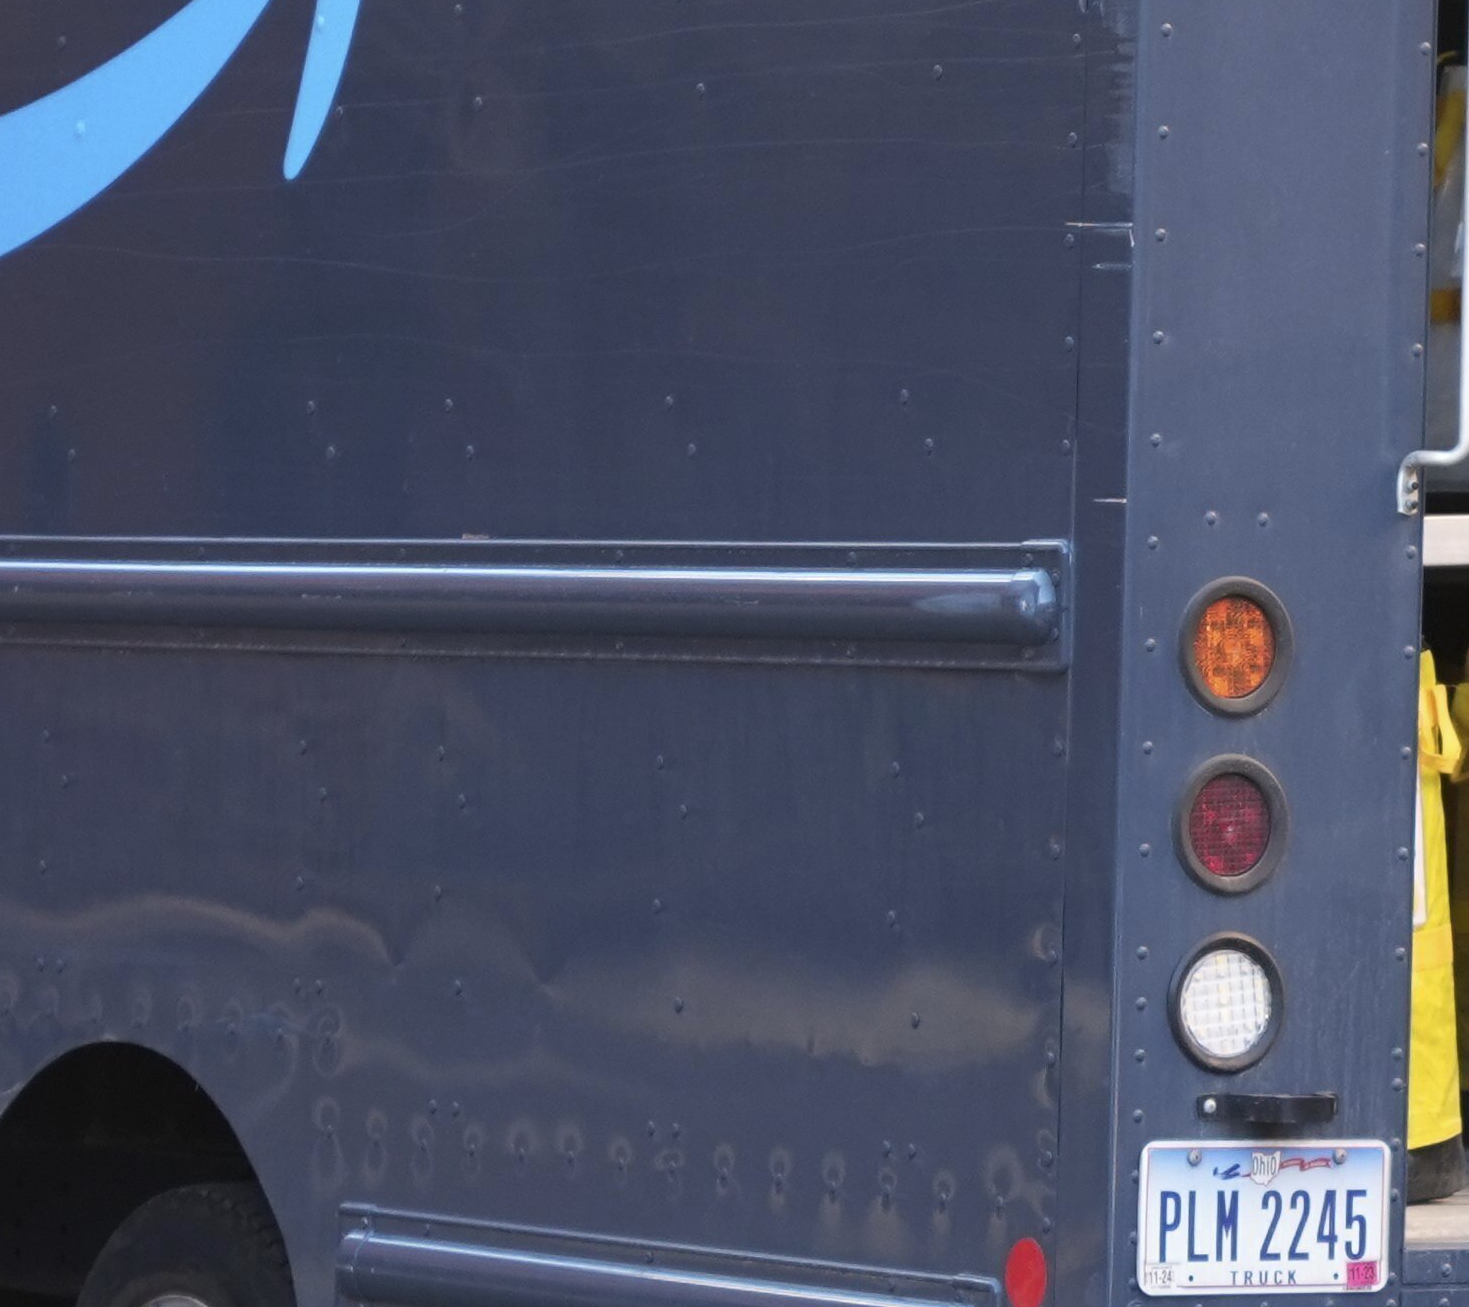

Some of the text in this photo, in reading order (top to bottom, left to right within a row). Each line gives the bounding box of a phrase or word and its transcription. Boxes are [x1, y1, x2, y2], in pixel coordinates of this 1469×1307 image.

[1159, 1189, 1368, 1263] PLM 2245
[1230, 1270, 1297, 1286] TRUCK
